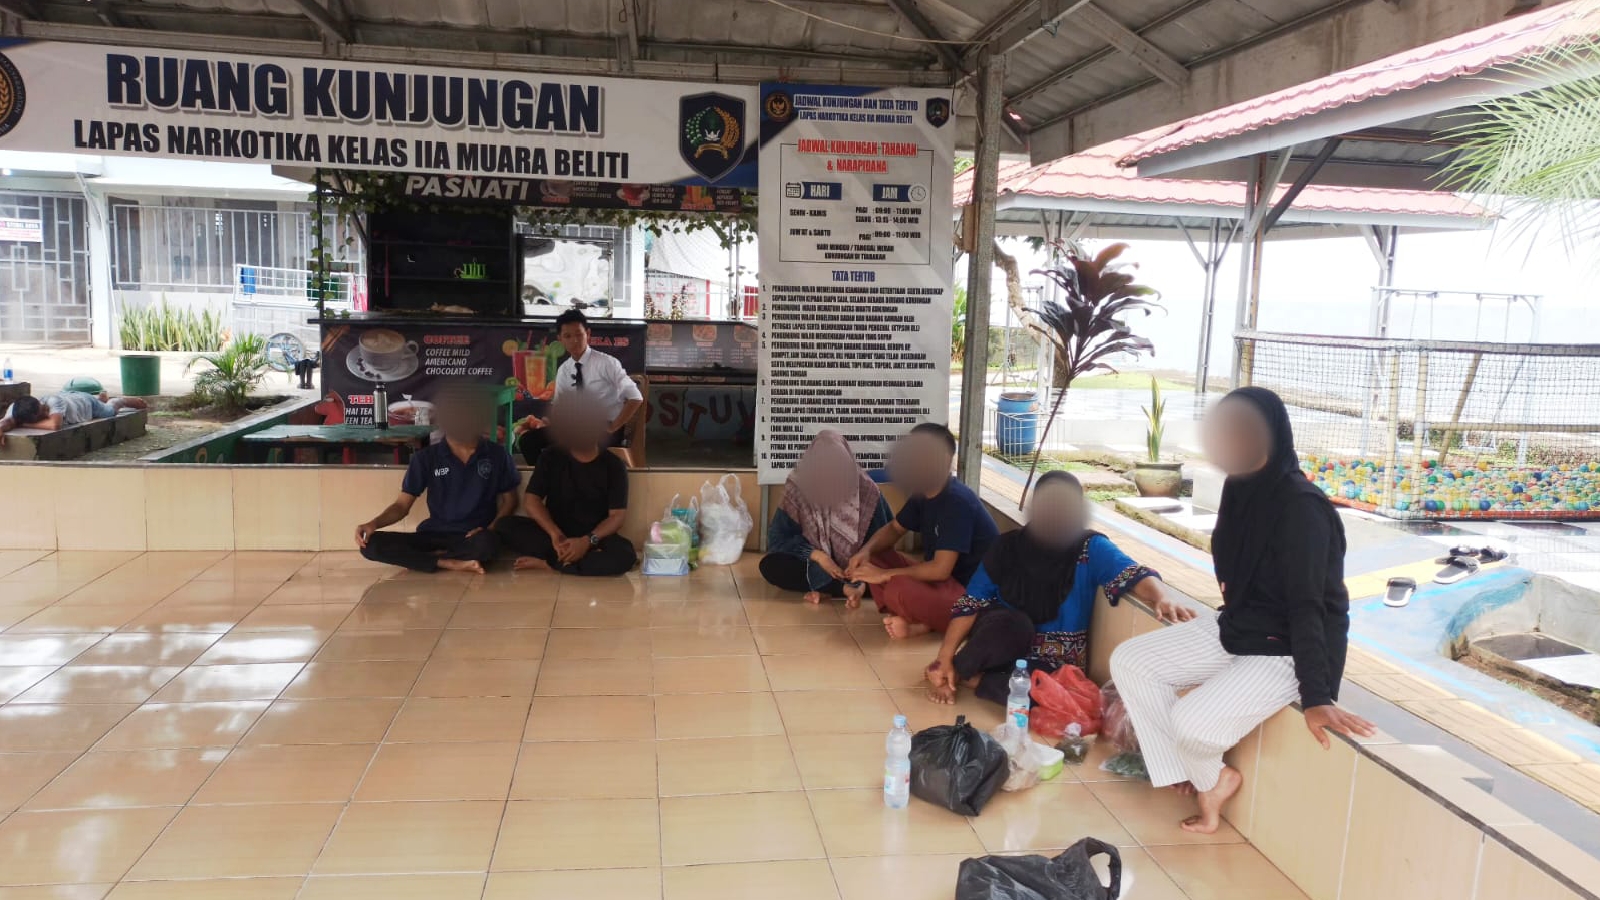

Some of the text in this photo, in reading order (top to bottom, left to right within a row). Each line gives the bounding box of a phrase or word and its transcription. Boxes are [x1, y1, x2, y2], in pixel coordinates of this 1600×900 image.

[107, 54, 599, 133] RUANG KUNJUNGAN
[795, 95, 821, 106] JADWAL
[822, 97, 862, 108] KUNJUNGAN
[863, 98, 877, 109] DAN
[879, 99, 894, 110] TATA
[74, 120, 629, 179] LAPAS NARKOTIKA KELAS IIA MUARA BELITI
[798, 139, 917, 156] JADWAL KUNJUNGAN TAHANAN
[827, 159, 887, 173] & NARAPIDANA
[405, 175, 529, 201] PASNATI
[811, 185, 830, 198] HARI
[882, 187, 898, 199] JAM
[832, 271, 875, 282] TATA TERTIB
[426, 349, 470, 357] COFFEE MILD
[425, 358, 467, 366] AMERICANO
[348, 395, 374, 405] TEH
[346, 408, 373, 416] HAI TEA
[346, 417, 373, 425] EEN TEA
